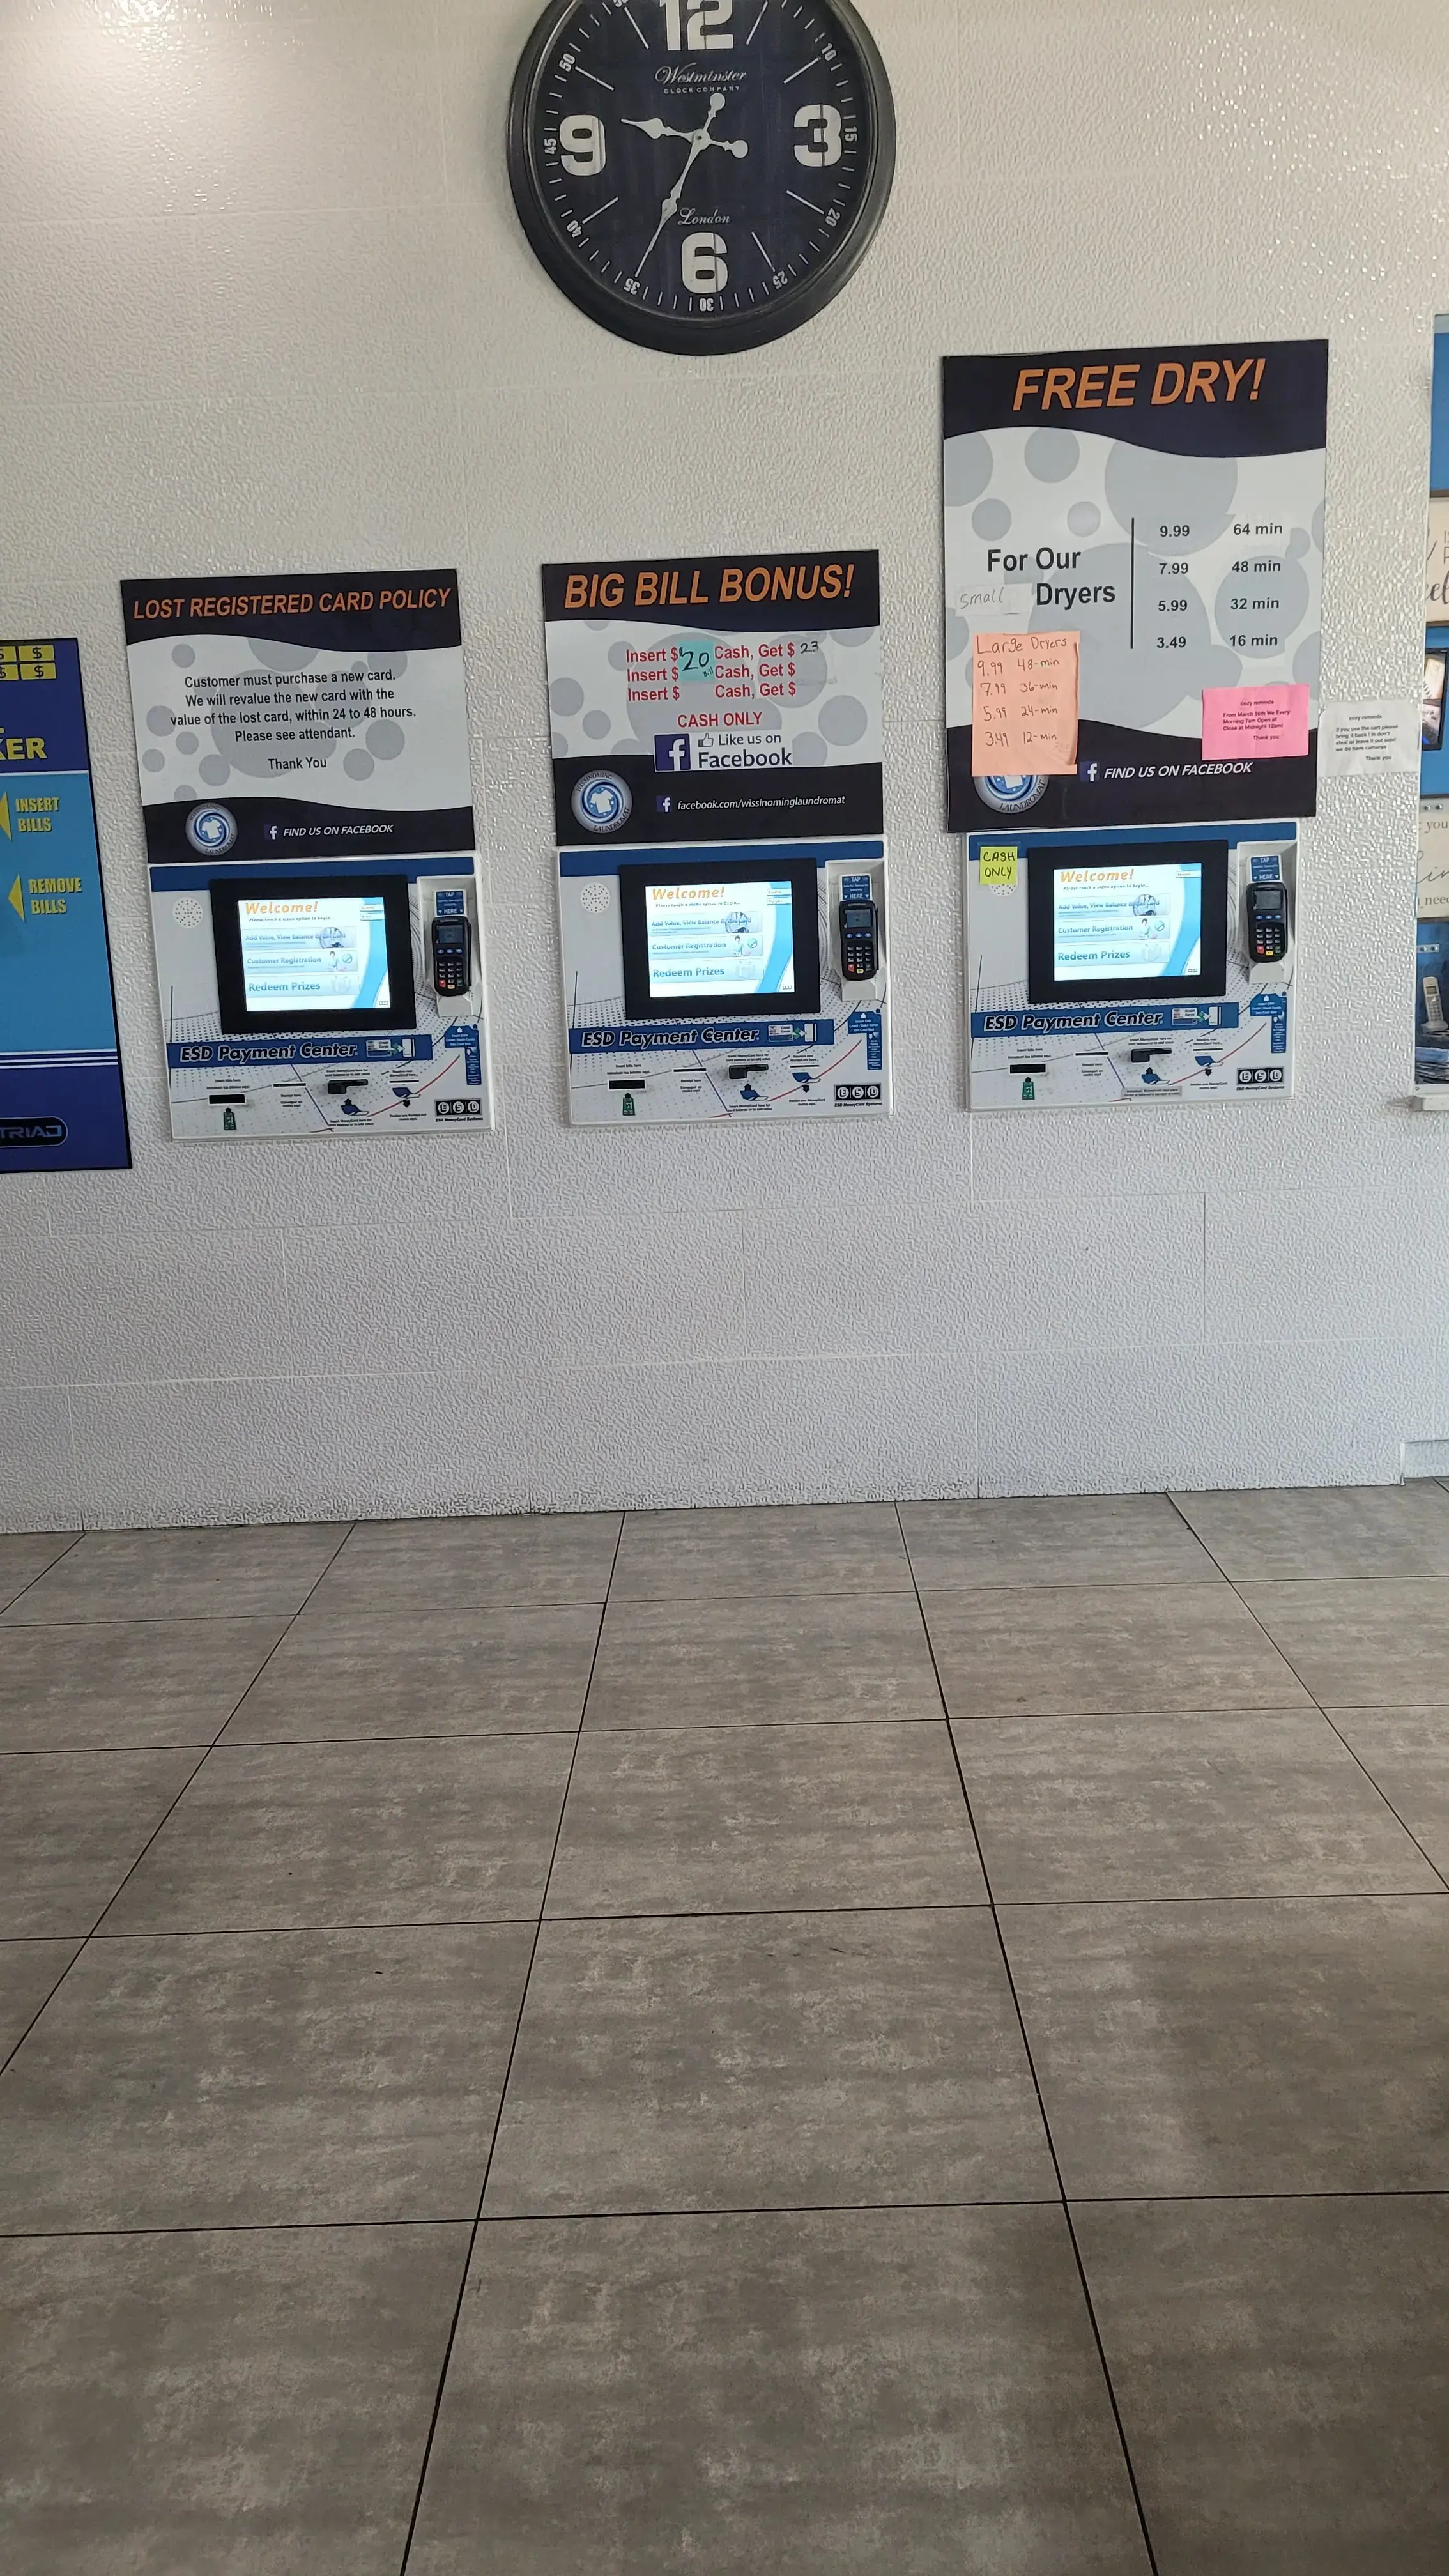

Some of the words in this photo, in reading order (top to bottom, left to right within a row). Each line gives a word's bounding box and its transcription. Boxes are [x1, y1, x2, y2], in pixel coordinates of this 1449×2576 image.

[659, 0, 734, 51] 12
[822, 42, 837, 61] 10
[559, 54, 576, 72] 50
[655, 63, 747, 84] Westminster
[794, 104, 842, 167] 3
[845, 126, 857, 142] 15
[544, 139, 556, 154] 45
[560, 115, 606, 176] 9
[678, 208, 731, 226] London
[825, 209, 840, 227] 20
[567, 220, 582, 238] 40
[682, 232, 728, 293] 6
[624, 278, 640, 295] 35
[773, 272, 788, 289] 25
[700, 298, 714, 312] 30
[1013, 364, 1140, 411] FREE
[1151, 358, 1266, 404] DRY!
[1160, 525, 1190, 537] 9.99
[1233, 523, 1251, 535] 64
[1255, 523, 1283, 535] min
[987, 549, 1028, 572] For
[1036, 547, 1081, 569] Our
[1232, 560, 1249, 573] 48
[1254, 560, 1281, 572] min
[1158, 562, 1189, 575] 7.99
[564, 572, 624, 608] BIG
[634, 570, 709, 606] BILL
[719, 564, 855, 603] BONUS!
[133, 598, 185, 619] LOST
[190, 594, 314, 617] REGISTERED
[319, 591, 374, 612] CARD
[379, 588, 452, 610] POLICY
[960, 585, 1004, 609] small
[1036, 582, 1116, 611] Dryers
[1230, 598, 1248, 610] 32
[1252, 597, 1280, 610] min
[1158, 599, 1188, 612] 5.99
[976, 635, 1023, 654] Large
[1031, 637, 1067, 650] Dryers
[1156, 636, 1186, 649] 3.49
[1229, 634, 1245, 647] 16
[1251, 634, 1278, 646] min
[626, 648, 667, 663] Insert
[670, 647, 678, 663] $
[714, 646, 754, 660] Cash,
[758, 644, 783, 657] Get
[787, 642, 795, 657] $
[800, 641, 819, 654] 23
[627, 668, 668, 682] Insert
[671, 666, 679, 682] $
[715, 665, 755, 680] Cash,
[758, 663, 783, 677] Get
[787, 661, 795, 677] $
[977, 660, 1003, 676] 9.99
[1017, 657, 1060, 670] 48-min
[185, 675, 240, 687] Customer
[243, 673, 272, 686] must
[275, 671, 328, 686] purchase
[332, 674, 338, 683] a
[341, 673, 364, 682] new
[367, 670, 396, 682] card.
[628, 687, 669, 702] Insert
[671, 686, 680, 702] $
[715, 684, 755, 699] Cash,
[759, 682, 784, 696] Get
[788, 680, 796, 696] $
[979, 682, 1007, 696] 7.99
[1020, 682, 1057, 693] 36-min
[186, 694, 204, 707] We
[206, 693, 226, 706] will
[229, 692, 272, 705] revalue
[274, 691, 293, 703] the
[295, 693, 318, 702] new
[321, 689, 346, 702] card
[349, 689, 373, 701] with
[376, 688, 394, 700] the
[171, 714, 201, 726] value
[204, 713, 215, 725] of
[218, 712, 236, 724] the
[239, 711, 261, 723] lost
[264, 710, 293, 725] card,
[295, 709, 330, 721] within
[333, 709, 346, 720] 24
[349, 709, 360, 719] to
[364, 707, 377, 719] 48
[380, 706, 417, 718] hours.
[677, 712, 719, 727] CASH
[723, 711, 763, 726] ONLY
[983, 706, 1008, 721] 5.99
[1021, 706, 1058, 717] 24-min
[235, 730, 272, 742] Please
[275, 732, 295, 740] see
[298, 726, 355, 739] attendant.
[718, 733, 744, 746] Like
[747, 735, 762, 744] us
[765, 735, 781, 744] on
[985, 732, 1009, 747] 3.49
[1023, 732, 1057, 744] 12-min
[268, 758, 303, 770] Thank
[305, 756, 327, 768] You
[698, 748, 792, 769] Facebook
[1104, 768, 1136, 778] FIND
[1138, 768, 1155, 778] US
[1158, 767, 1178, 777] ON
[1181, 762, 1254, 776] FACEBOOK
[677, 795, 845, 811] facebook.com/wissinominglaundromat
[999, 779, 1046, 812] LAUNDROMAT
[15, 796, 60, 813] INSERT
[18, 816, 52, 832] BILLS
[593, 806, 630, 831] LAUNDROMAT
[284, 827, 306, 836] FIND
[309, 827, 321, 836] US
[323, 826, 339, 834] ON
[341, 824, 394, 834] FACEBOOK
[983, 851, 1015, 862] CASH
[985, 866, 1013, 878] ONLY
[1061, 869, 1134, 882] Welcome!
[29, 877, 82, 893] REMOVE
[652, 887, 725, 900] Welcome!
[31, 899, 67, 915] BILLS
[245, 901, 318, 914] Welcome!
[1058, 952, 1098, 960] Redeem
[1101, 951, 1130, 959] Prizes
[653, 969, 693, 977] Redeem
[696, 967, 724, 976] Prizes
[249, 983, 288, 991] Redeem
[292, 982, 320, 990] Prizes
[985, 1016, 1016, 1031] ESD
[1022, 1014, 1100, 1033] Payment
[1106, 1012, 1162, 1027] Center
[581, 1032, 614, 1047] ESD
[620, 1031, 696, 1048] Payment
[703, 1028, 758, 1043] Center
[181, 1046, 213, 1062] ESD
[219, 1046, 296, 1064] Payment
[302, 1043, 356, 1058] Center
[0, 1125, 61, 1138] TRIAD
